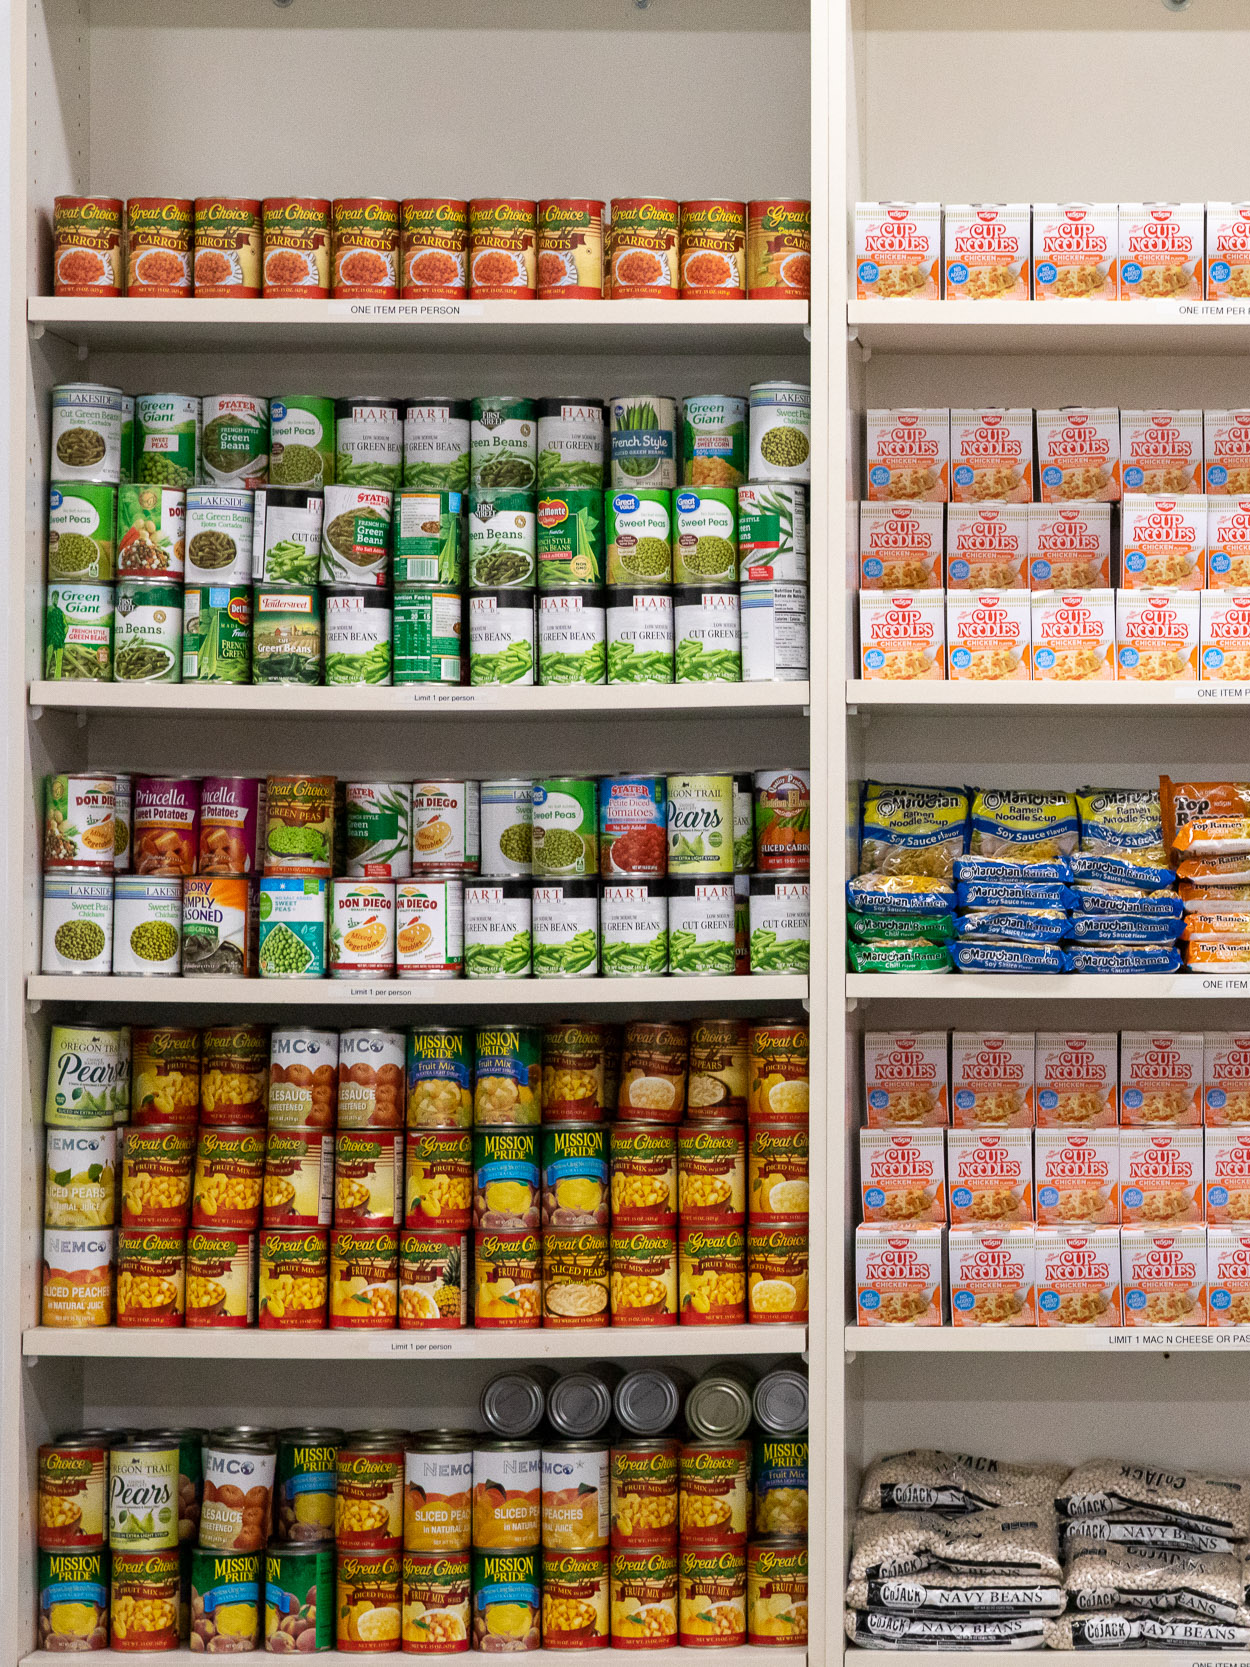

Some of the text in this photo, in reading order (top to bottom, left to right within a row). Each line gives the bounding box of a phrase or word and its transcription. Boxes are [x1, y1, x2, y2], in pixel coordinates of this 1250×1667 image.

[638, 204, 674, 222] Choice
[707, 205, 743, 224] Choice
[767, 205, 806, 227] Great
[617, 235, 666, 250] CARROTS
[686, 236, 735, 251] CARROTS
[350, 305, 460, 315] ONE ITEM PER PERSON
[1178, 306, 1199, 315] ONE
[1201, 306, 1224, 315] ITEM
[1226, 306, 1246, 315] PER
[140, 400, 174, 412] Green
[218, 400, 256, 413] STATER
[689, 402, 725, 414] Green
[143, 411, 175, 423] Giant
[353, 407, 397, 420] HART
[692, 412, 725, 425] Giant
[221, 441, 250, 451] Beans
[493, 437, 528, 448] Beans
[612, 435, 668, 449] French Style
[619, 518, 666, 528] Sweet Peas
[543, 632, 596, 641] GREEN BEANS
[414, 694, 431, 702] Limit
[1197, 688, 1218, 697] ONE
[1220, 688, 1243, 697] ITEM
[611, 785, 650, 797] STATER
[695, 789, 723, 798] TRAIL
[136, 789, 185, 806] Princella
[426, 798, 458, 809] DIEGO
[630, 799, 650, 807] Diced
[154, 808, 189, 822] Potatoes
[269, 808, 322, 822] GREEN PEAS
[607, 806, 654, 818] Tomatoes
[668, 801, 723, 829] Pears
[995, 812, 1057, 823] Noodle Soup
[995, 825, 1068, 841] Soy Sauce Flavor
[363, 898, 392, 910] DIEGO
[634, 922, 660, 931] BEANS
[864, 919, 912, 931] Maruchan
[970, 949, 1059, 966] Maruchan Ramen
[1202, 980, 1223, 989] ONE
[1225, 980, 1248, 989] ITEM
[350, 988, 368, 997] Limit
[375, 990, 386, 998] per
[418, 1061, 455, 1071] Fruit Mix
[485, 1136, 534, 1156] MISSION
[351, 1267, 386, 1277] FRUIT MIX
[1132, 1263, 1196, 1280] NOODLES
[44, 1285, 110, 1297] SLICED PEACHES
[53, 1301, 104, 1310] NATURAL JUICE
[1109, 1335, 1133, 1344] LIMIT
[1142, 1335, 1165, 1344] MAC
[1166, 1335, 1173, 1344] N
[1175, 1335, 1214, 1344] CHEESE
[1216, 1335, 1231, 1344] OR
[391, 1342, 408, 1350] Limit
[415, 1344, 427, 1352] per
[427, 1344, 452, 1352] person
[111, 1475, 172, 1507] Pears
[415, 1510, 449, 1522] SLICED
[431, 1525, 462, 1534] NATURAL
[485, 1556, 534, 1577] MISSION
